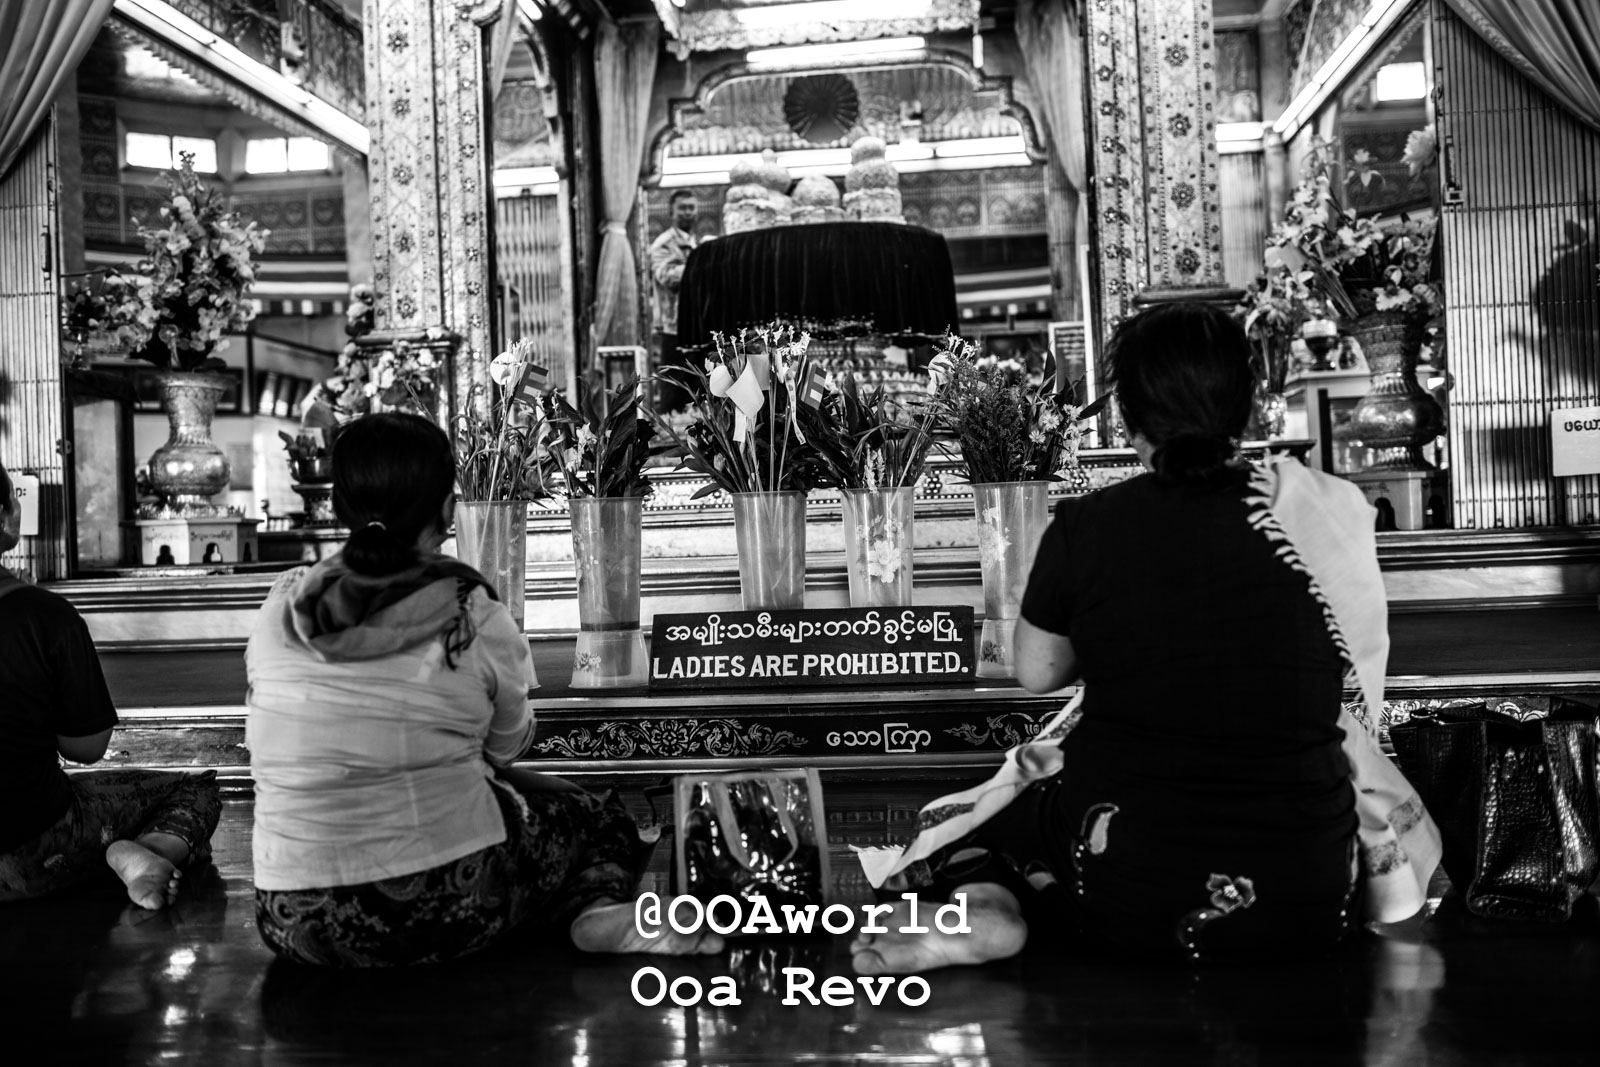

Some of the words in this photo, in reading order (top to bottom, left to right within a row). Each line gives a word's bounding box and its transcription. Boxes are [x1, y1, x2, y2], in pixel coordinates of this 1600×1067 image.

[653, 656, 746, 680] LADIES
[749, 656, 799, 677] ARE
[802, 652, 969, 677] PROHIBITED.
[826, 723, 931, 753] သောကြာ
